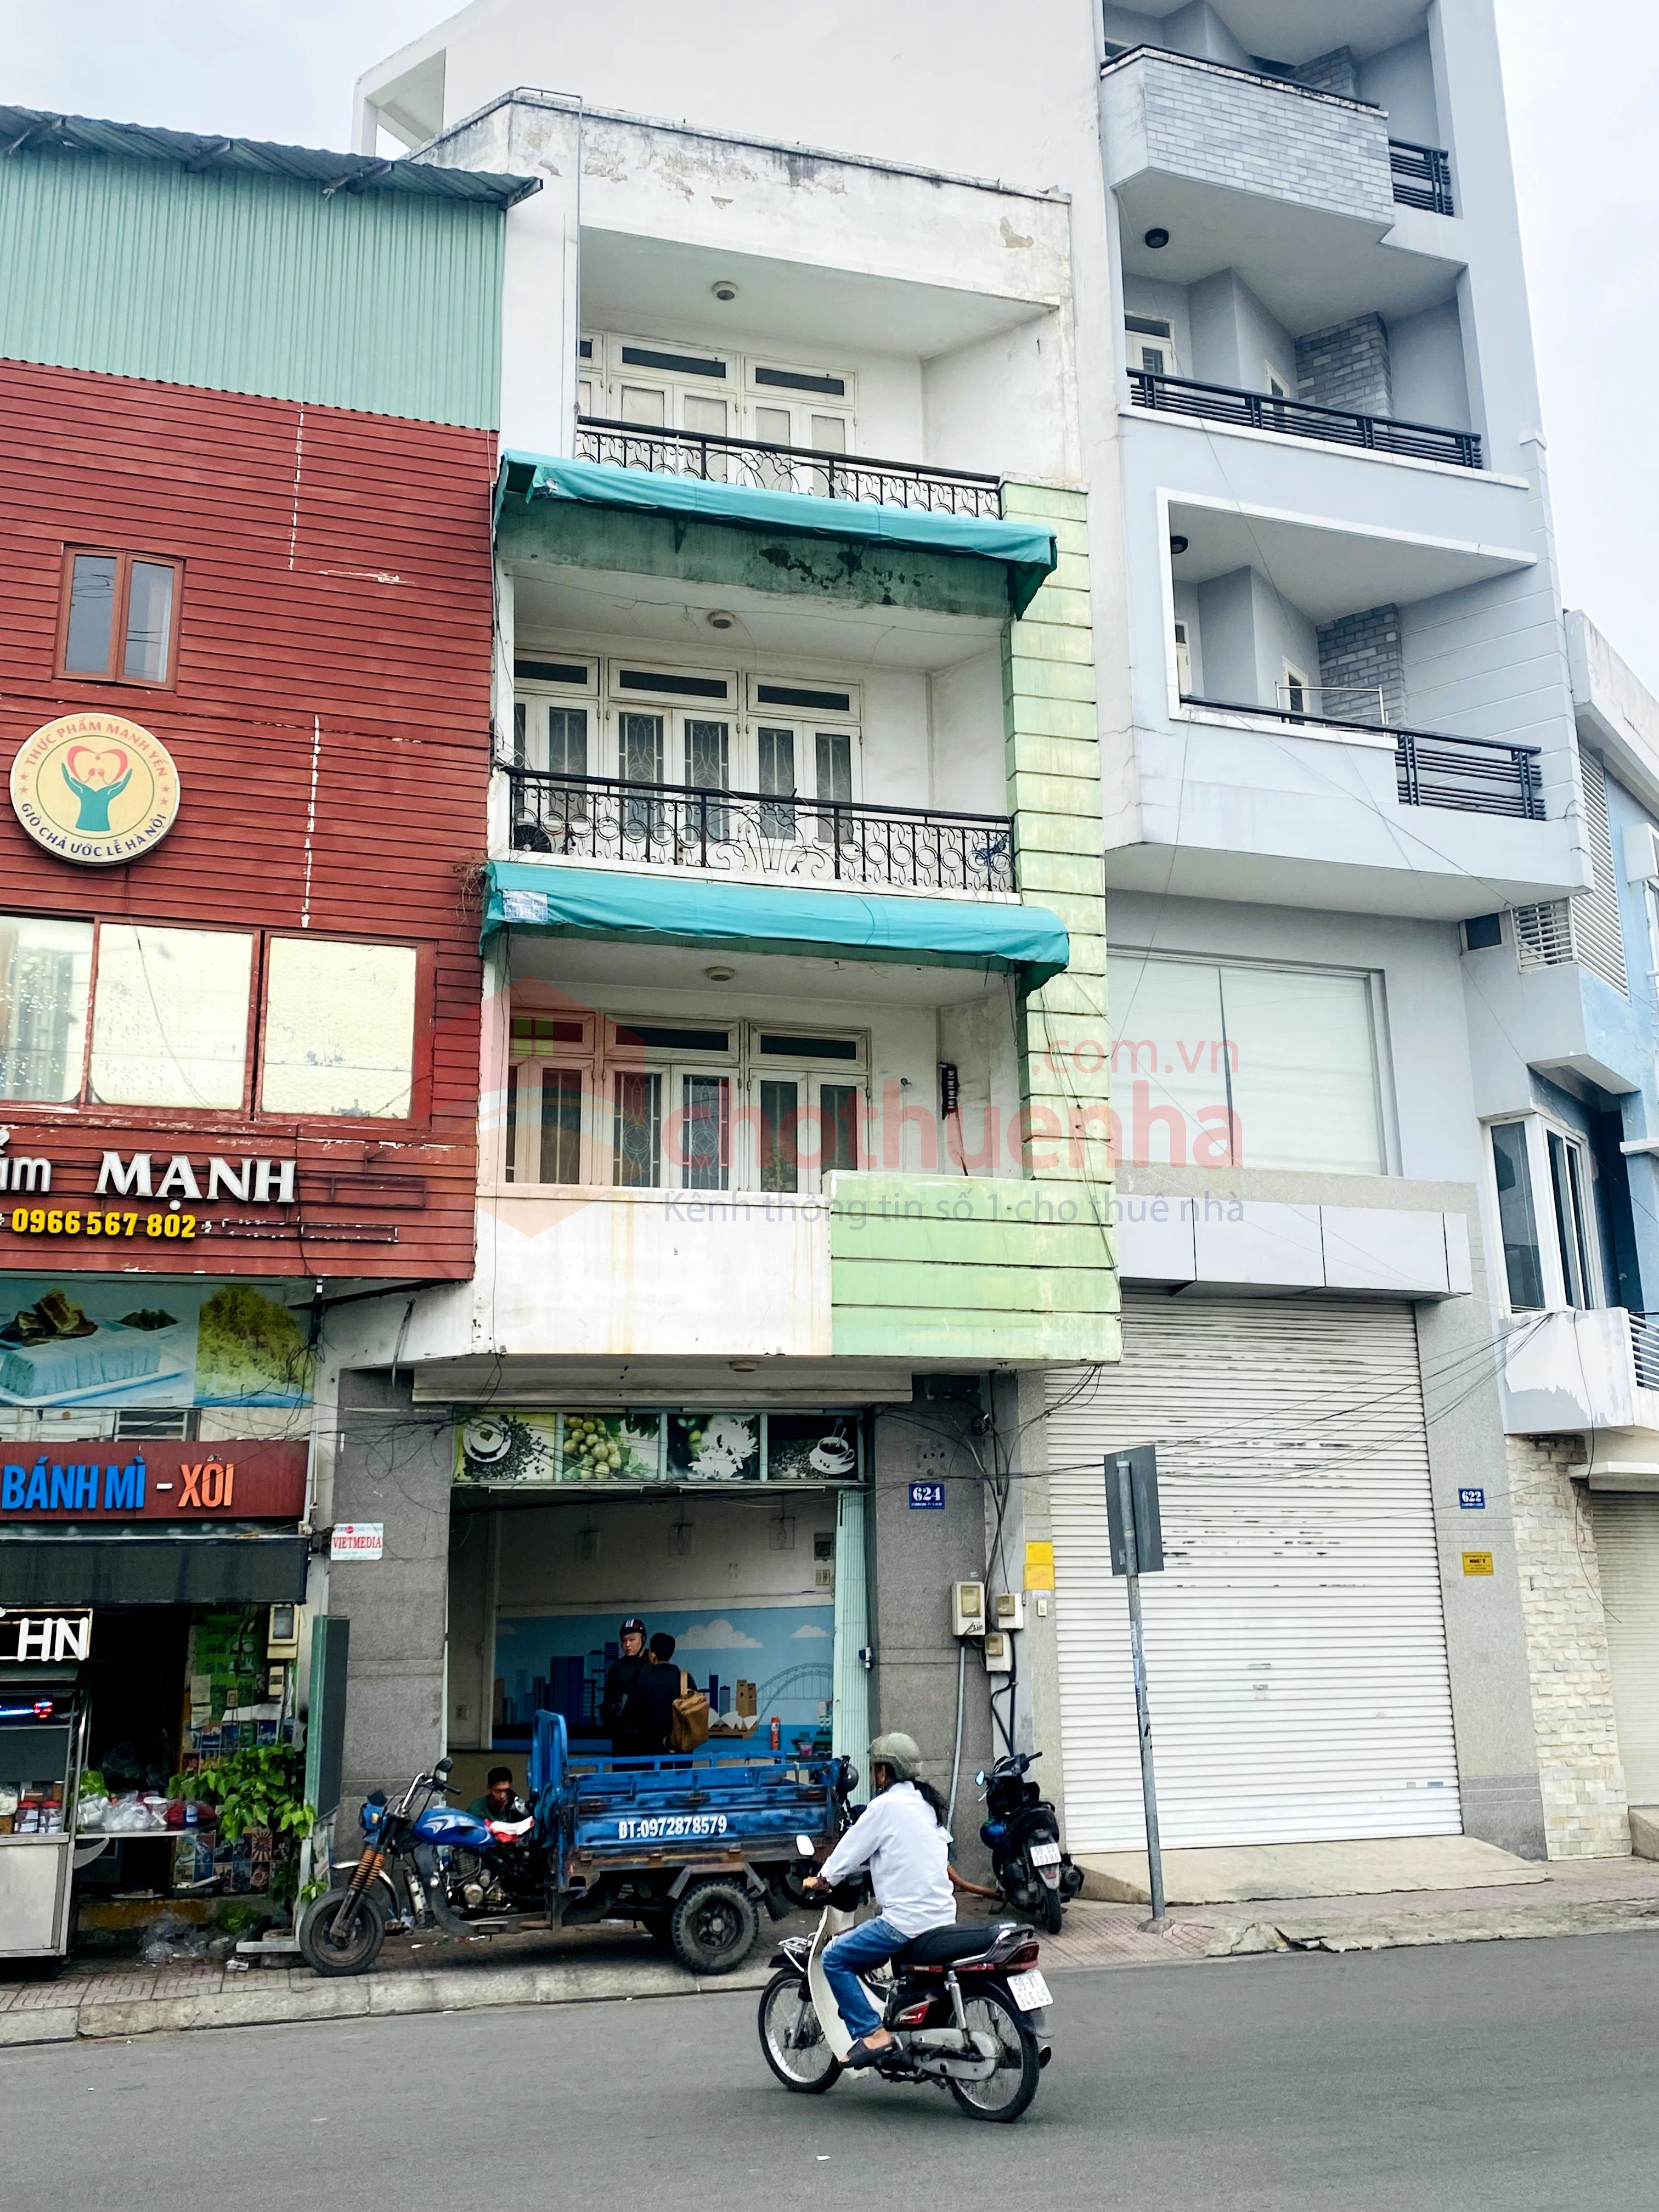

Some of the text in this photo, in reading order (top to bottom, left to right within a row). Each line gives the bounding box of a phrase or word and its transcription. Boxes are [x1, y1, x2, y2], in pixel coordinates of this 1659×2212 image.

[25, 718, 170, 777] THỰC PHẨM MẠNH YẾN
[22, 803, 167, 857] GIÒ CHẢ ƯỚC LỄ HÀ NỘI
[94, 1151, 297, 1211] MẠNH
[12, 1208, 196, 1238] 0966 567 802
[2, 1455, 99, 1509] BÁNH
[104, 1455, 146, 1509] MÌ
[178, 1454, 235, 1508] XÔI
[912, 1487, 941, 1502] 624
[1462, 1491, 1482, 1503] 622
[333, 1536, 382, 1549] VIETMEDIA
[17, 1617, 89, 1662] HN
